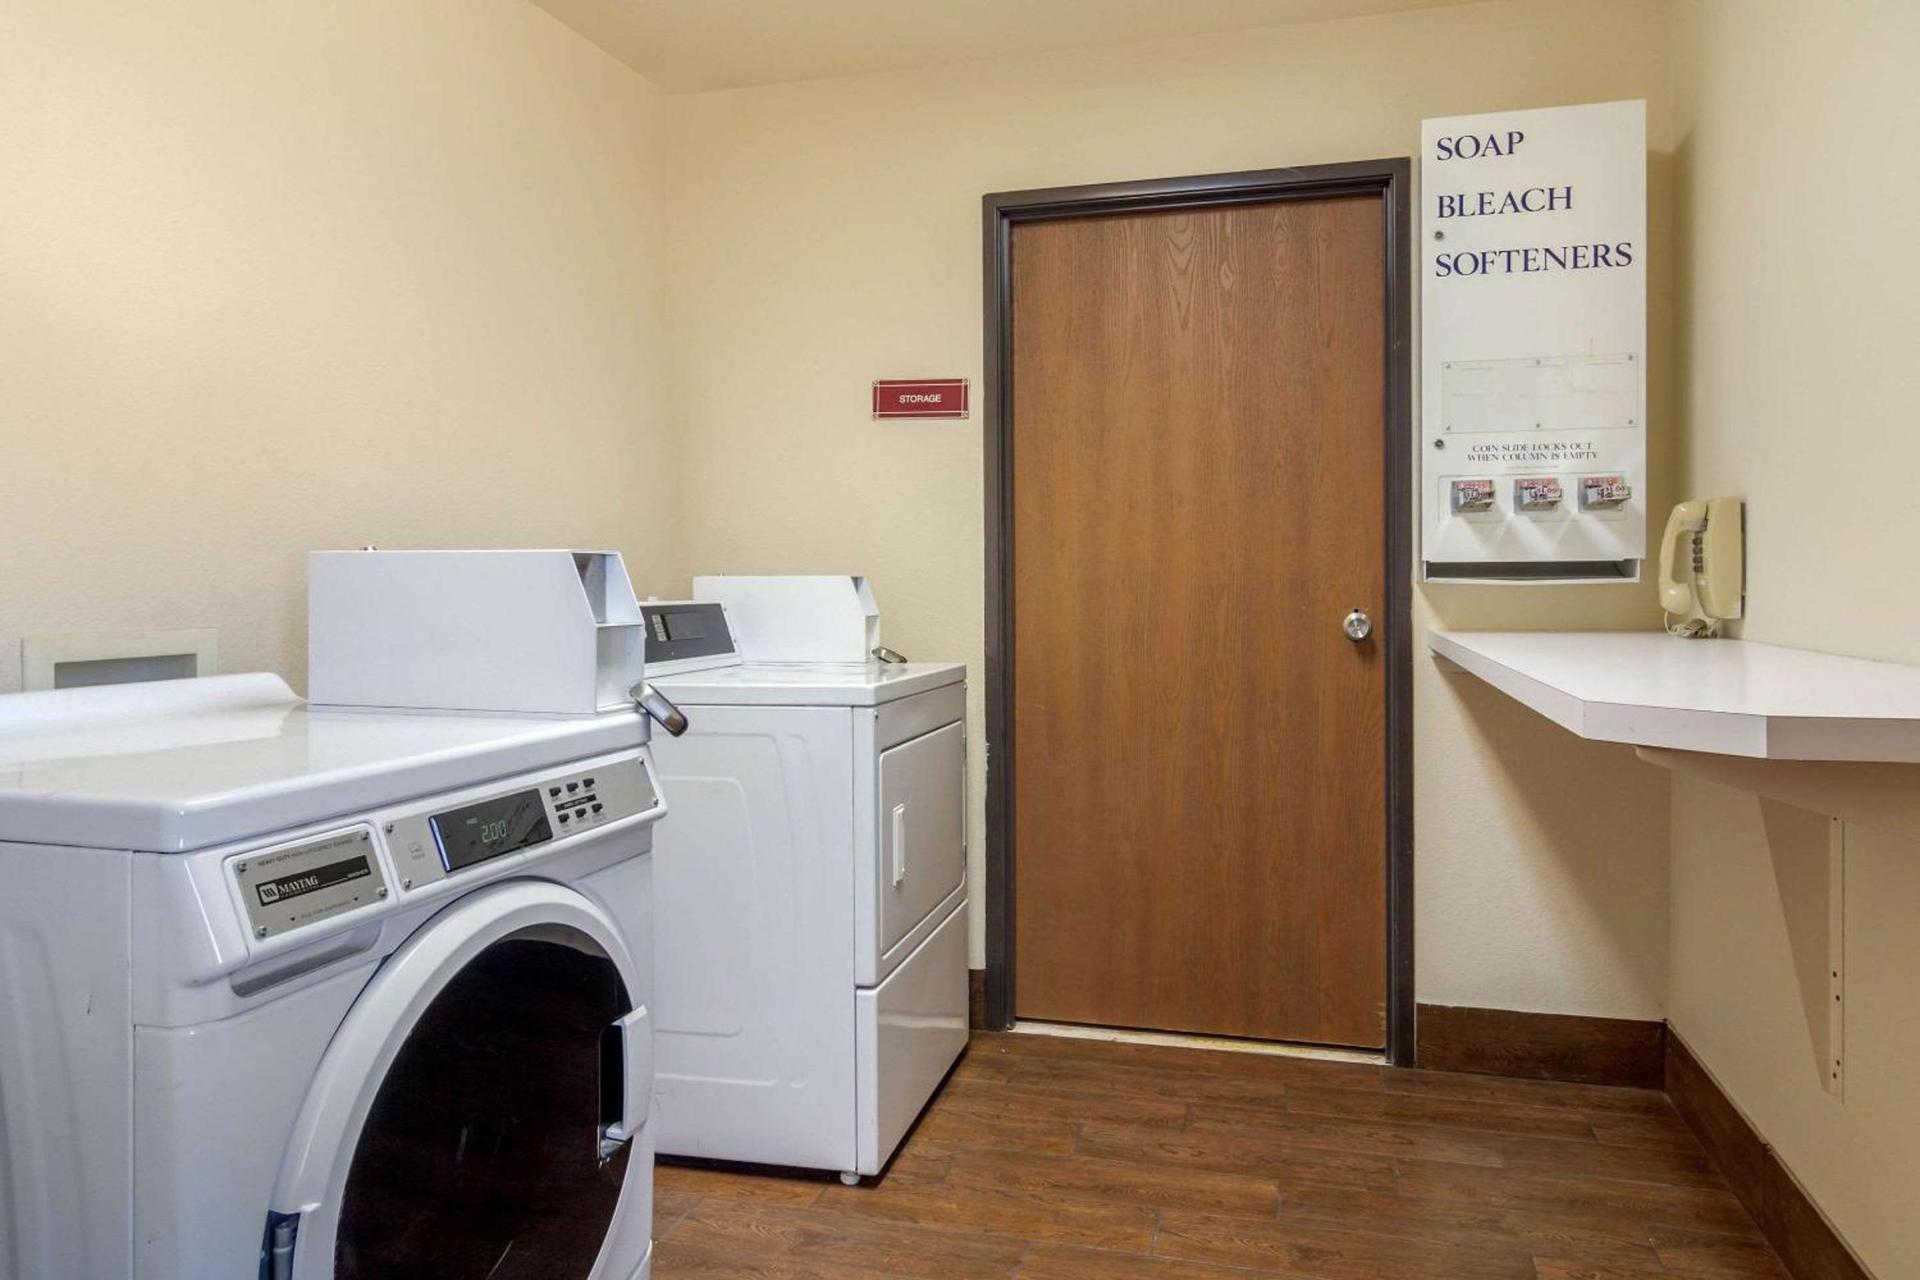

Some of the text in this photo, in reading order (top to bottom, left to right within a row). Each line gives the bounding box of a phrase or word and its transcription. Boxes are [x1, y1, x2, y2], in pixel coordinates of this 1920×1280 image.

[1436, 131, 1524, 161] SOAP
[1437, 186, 1573, 219] BLEACH
[1435, 242, 1633, 277] SOFTENERS
[899, 394, 942, 404] STORAGE
[1467, 451, 1598, 461] WHEN COLUMN IS EMPTY
[1472, 442, 1593, 453] COIN SLIDE LOCKS OUT
[278, 875, 319, 894] MAYTAG
